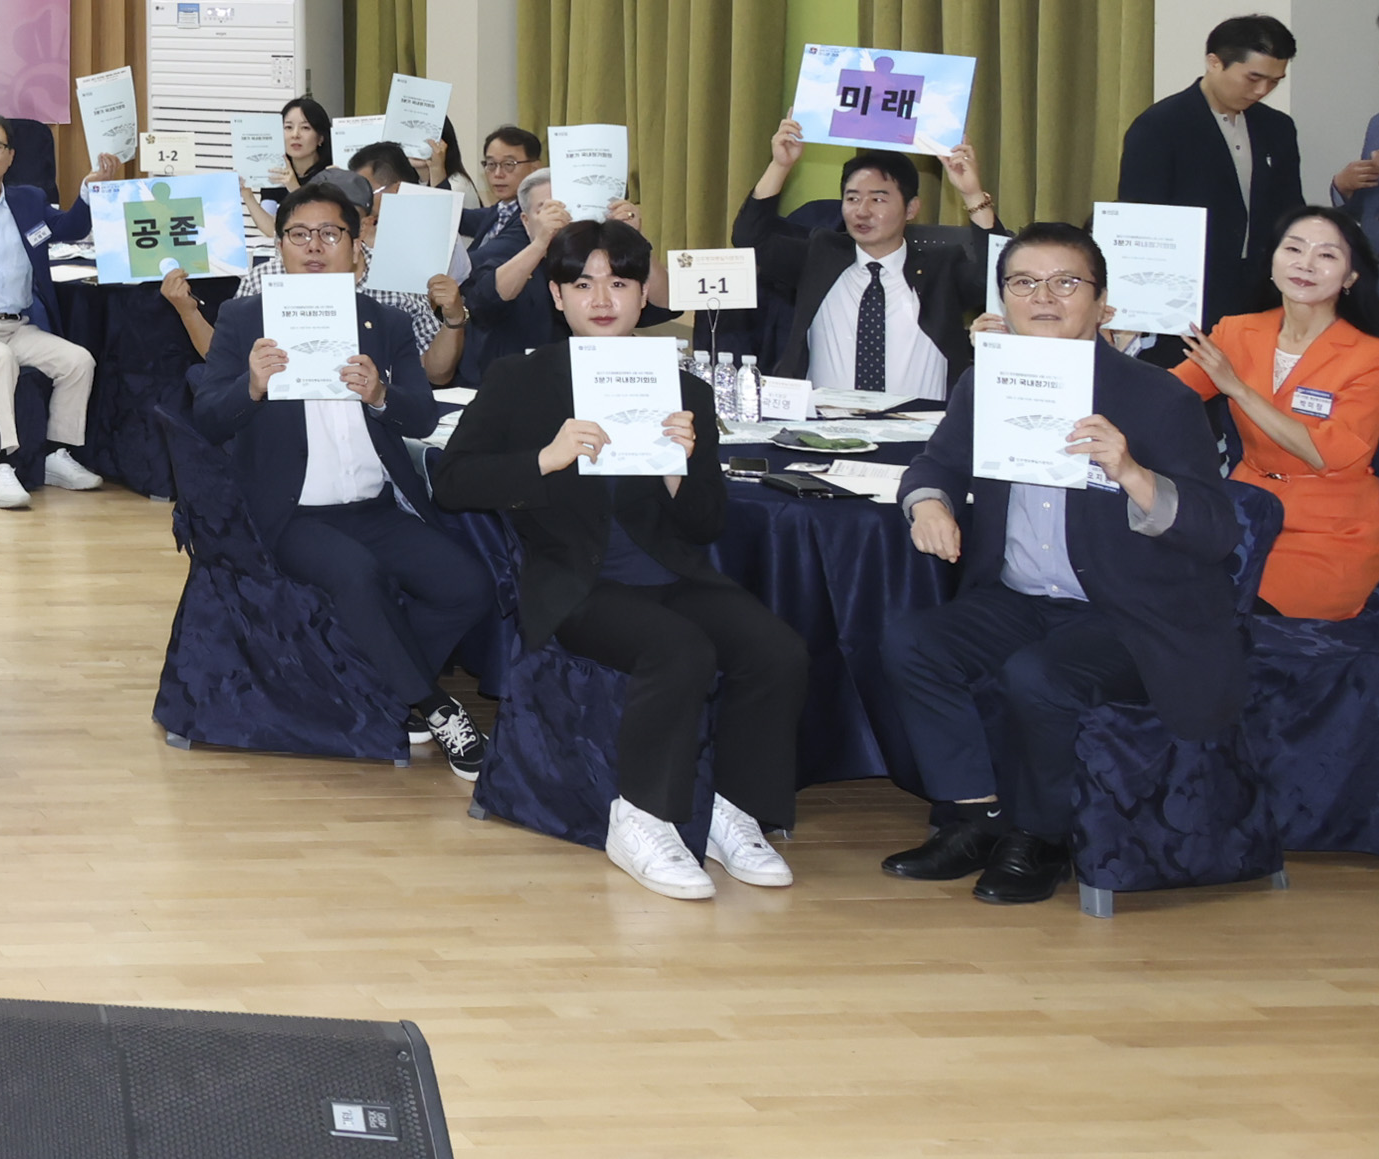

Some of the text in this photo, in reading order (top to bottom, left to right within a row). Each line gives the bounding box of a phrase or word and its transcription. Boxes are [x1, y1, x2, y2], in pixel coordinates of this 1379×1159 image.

[840, 85, 916, 120] 미래
[158, 150, 178, 162] 1-2
[131, 216, 199, 249] 공존
[697, 277, 729, 294] 1-1
[593, 376, 657, 384] 3분기 국내정기회의
